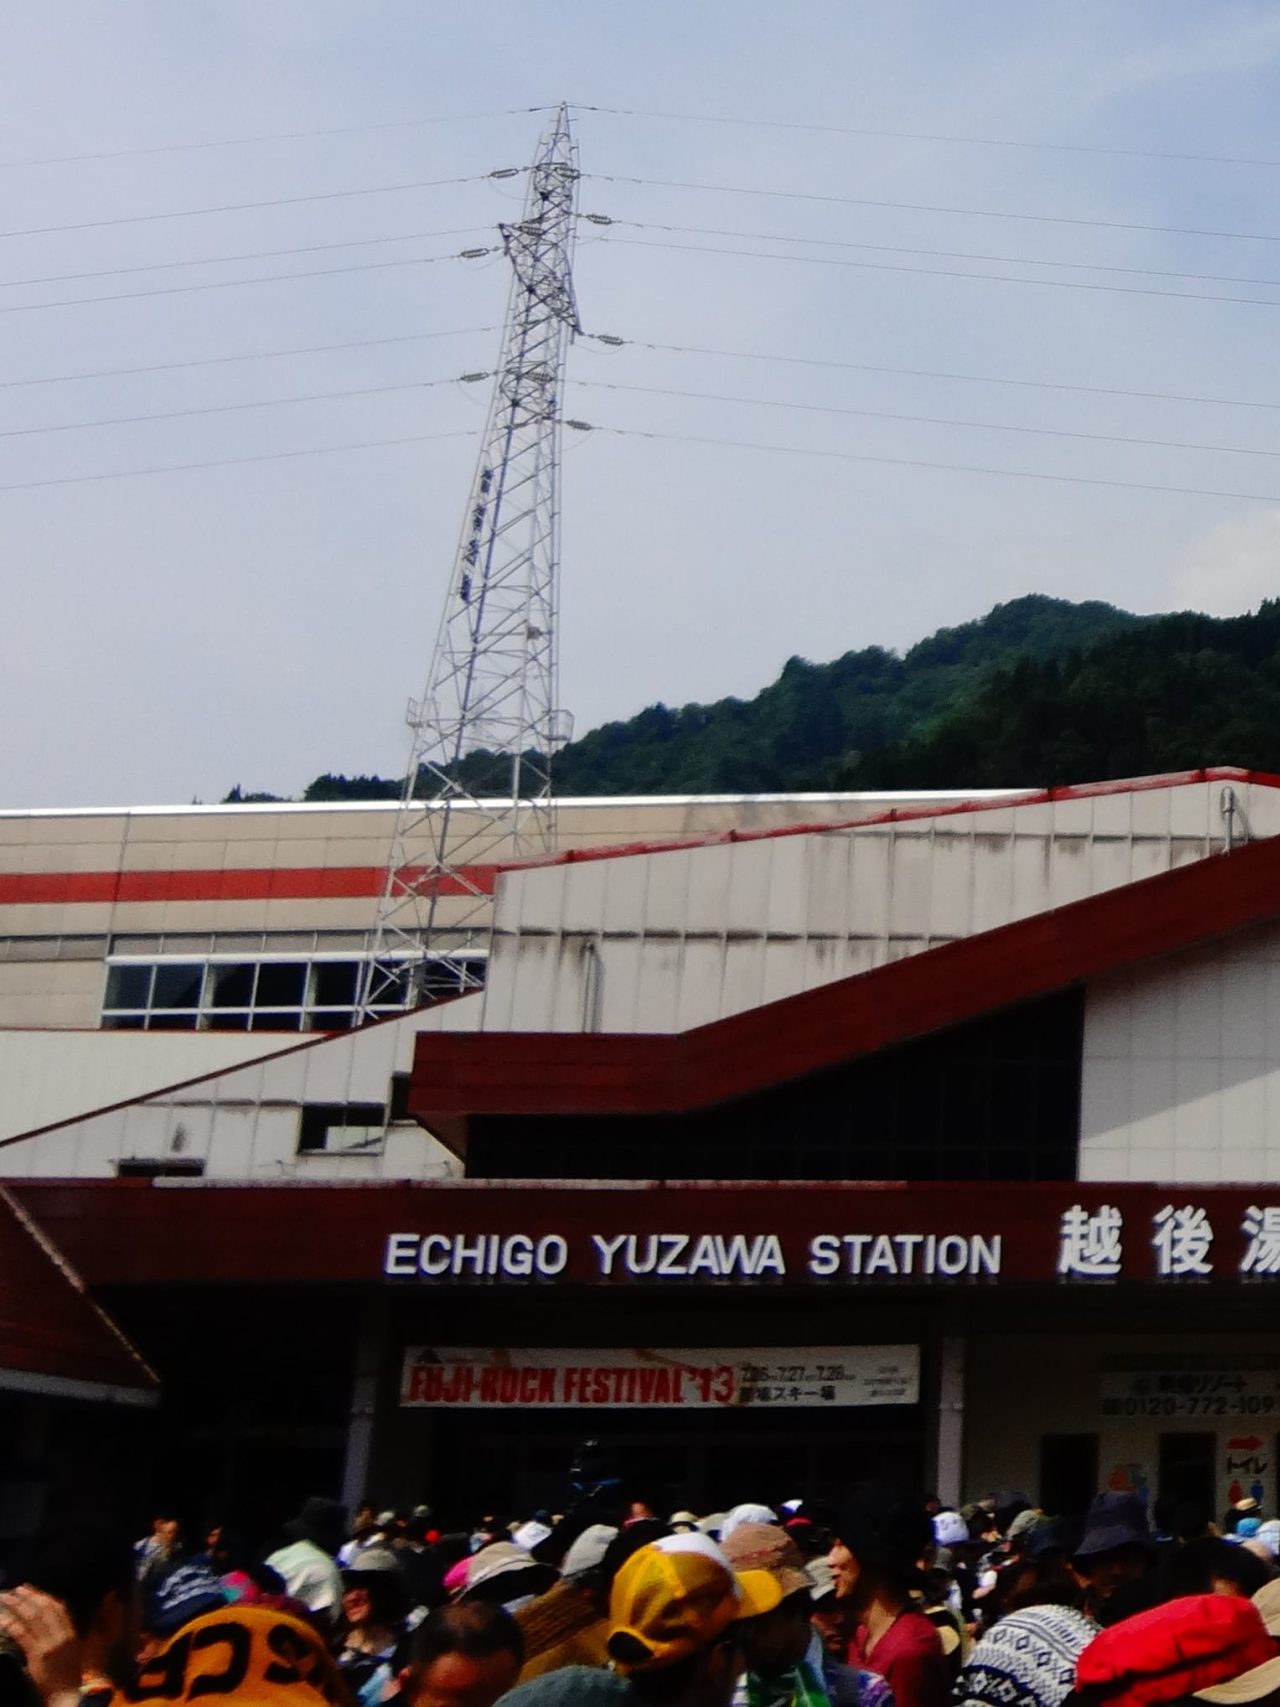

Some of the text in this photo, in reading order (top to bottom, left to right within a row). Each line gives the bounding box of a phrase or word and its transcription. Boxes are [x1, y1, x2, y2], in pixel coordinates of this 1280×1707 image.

[385, 1233, 1002, 1275] ECHIGO YUZAWA STATION
[564, 1367, 682, 1402] FESTIVAL
[1227, 1456, 1268, 1474] トイレ
